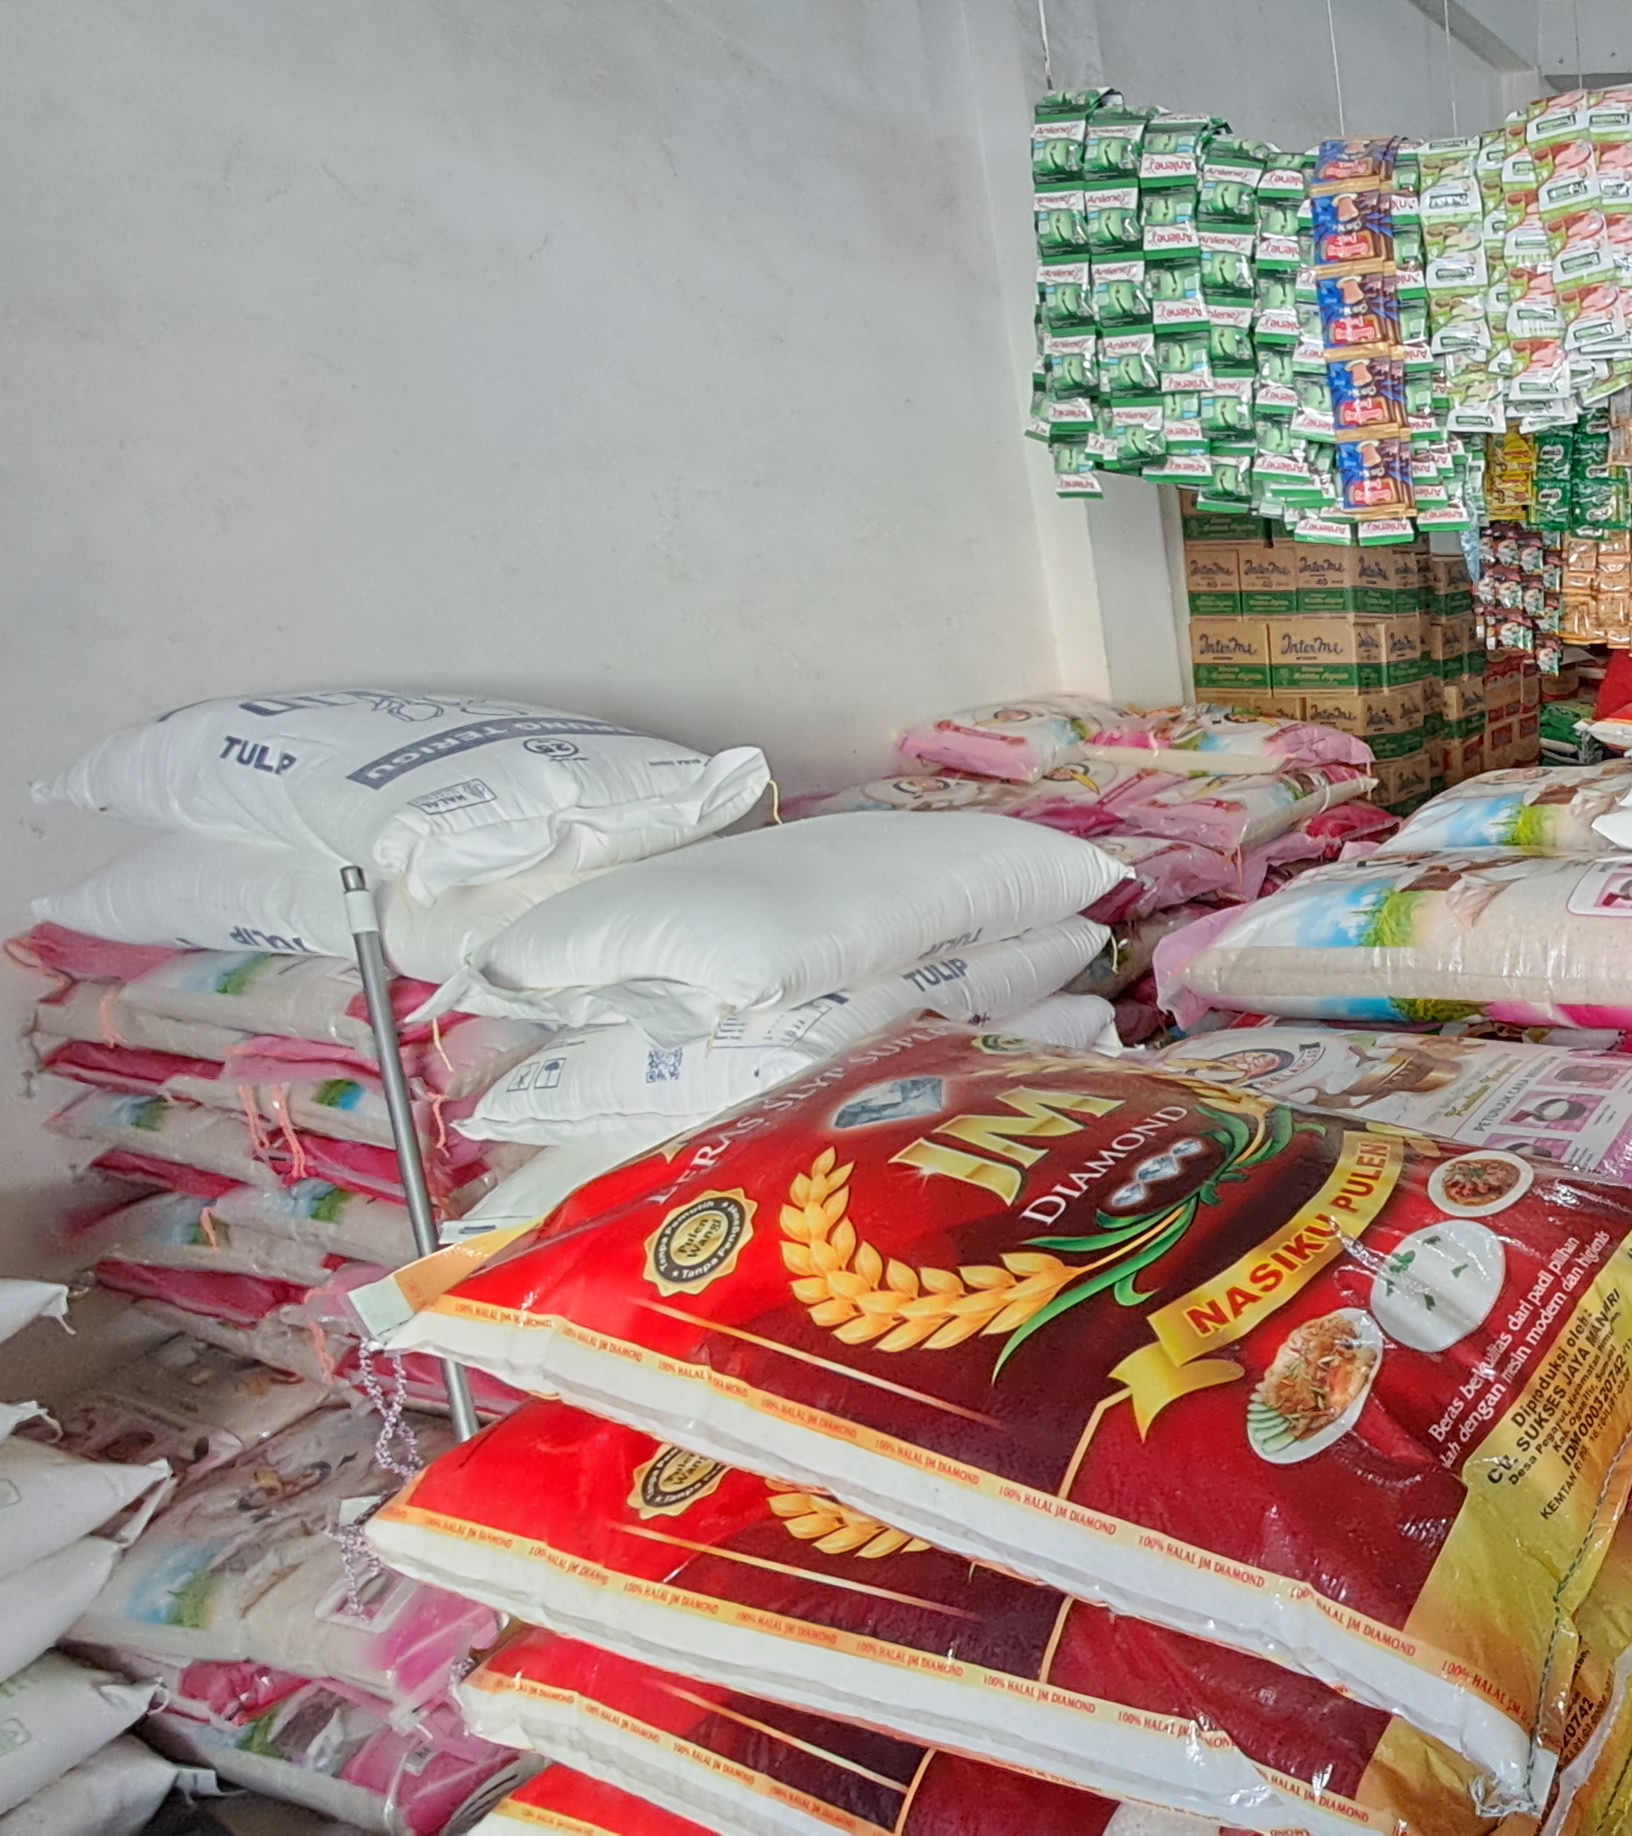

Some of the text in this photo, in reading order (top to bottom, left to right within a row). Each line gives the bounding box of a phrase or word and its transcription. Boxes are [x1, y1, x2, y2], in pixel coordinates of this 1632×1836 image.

[1154, 159, 1193, 171] Anlene
[1088, 193, 1124, 204] Anlene
[1154, 232, 1194, 243] Anlene
[367, 726, 510, 780] TERIGU
[902, 957, 969, 993] TULIP
[1020, 1104, 1189, 1227] DIAMOND
[677, 1218, 709, 1254] Pulen
[1186, 1138, 1390, 1336] NASIKU PULEN
[682, 1257, 719, 1279] Tanpa
[677, 1365, 705, 1380] HALAL
[1428, 1395, 1465, 1443] Beras
[1508, 1299, 1533, 1333] dari
[1527, 1270, 1555, 1306] padi
[1459, 1383, 1508, 1443] dengan
[1561, 1265, 1585, 1293] dan
[1511, 1345, 1570, 1429] Diproduksi
[1516, 1383, 1567, 1453] SUKSES
[1564, 1349, 1592, 1390] JAYA
[782, 1403, 807, 1423] HALAL
[897, 1444, 924, 1466] HALAL
[924, 1455, 936, 1470] JM
[937, 1458, 981, 1486] DIAMOND
[1508, 1454, 1538, 1486] Desa
[998, 1485, 1118, 1536] 100% HALAL JM DIAMOND
[1539, 1472, 1578, 1521] KEMTAN
[1138, 1534, 1266, 1588] 100% HALAL JM DIAMOND
[757, 1616, 784, 1633] HALAL
[1346, 1613, 1362, 1633] JM
[1362, 1617, 1417, 1657] DIAMOND
[856, 1641, 965, 1678] 100% HALAL JM DIAMOND
[982, 1673, 1097, 1714] 100% HALAL JM DIAMOND
[1471, 1672, 1505, 1703] HALAL
[1117, 1711, 1142, 1727] 100%
[1271, 1775, 1370, 1823] HALAL DIAMOND
